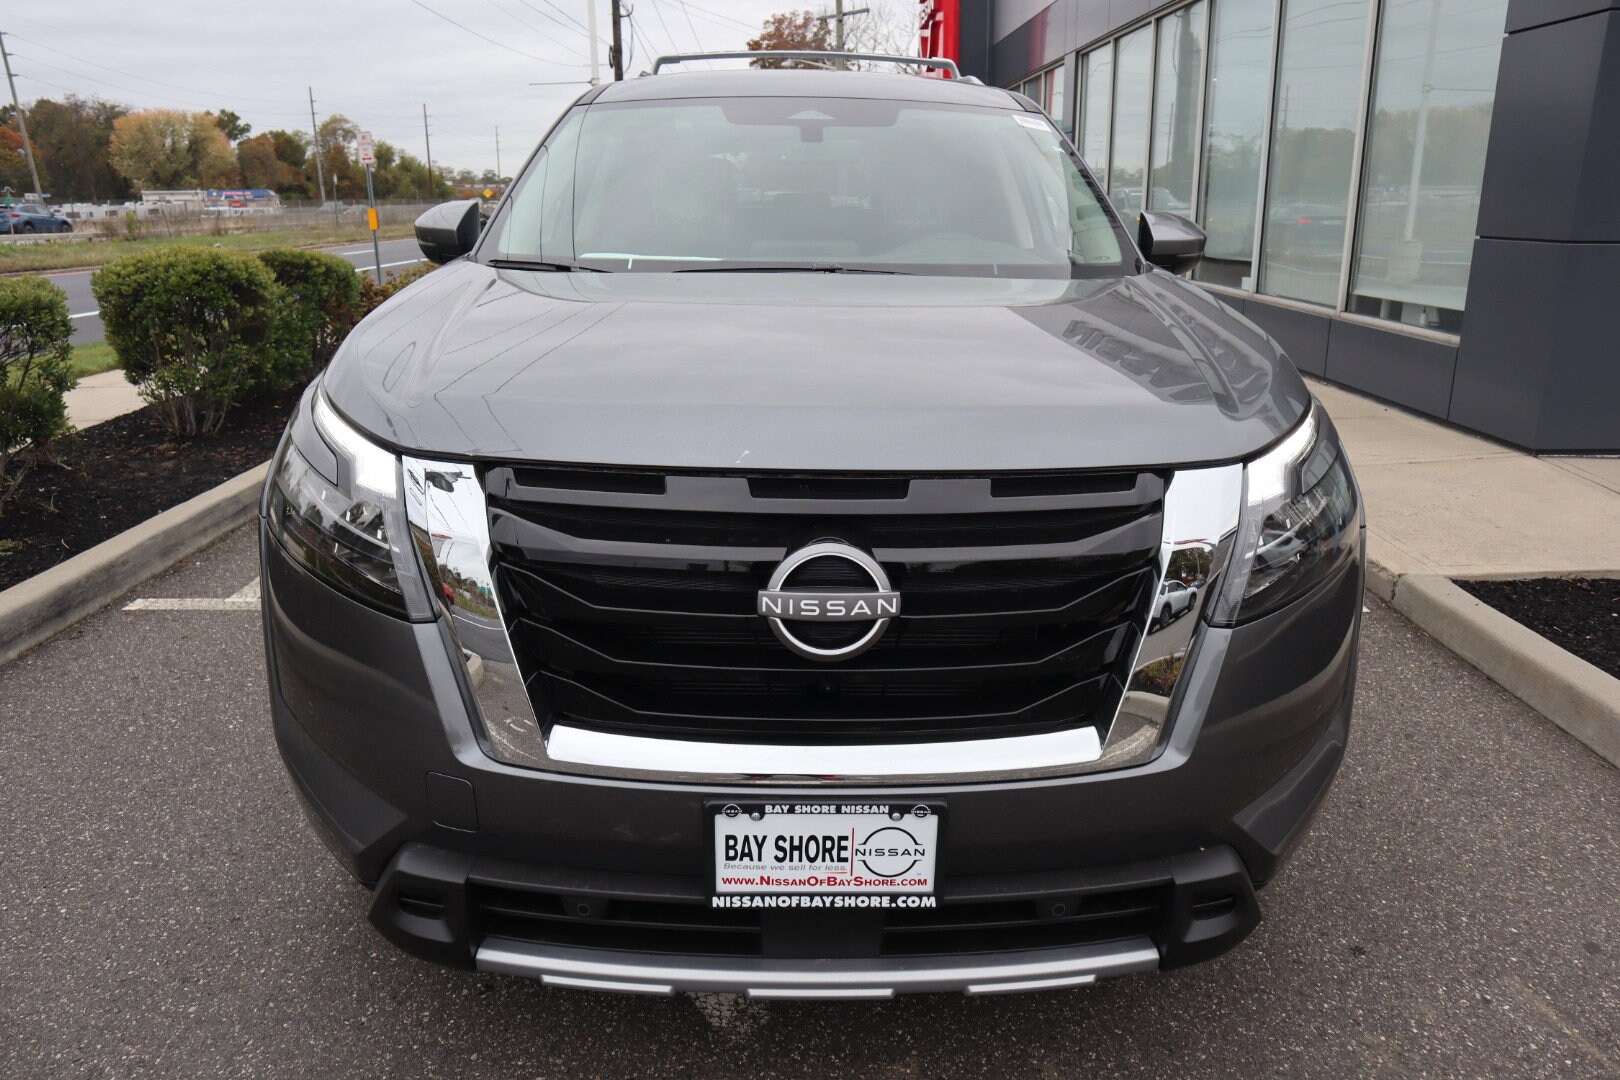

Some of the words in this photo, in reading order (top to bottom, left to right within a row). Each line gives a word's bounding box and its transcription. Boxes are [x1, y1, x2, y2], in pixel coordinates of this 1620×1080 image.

[762, 596, 897, 616] NISSAN
[765, 805, 789, 813] BAY
[795, 805, 836, 813] SHORE
[842, 805, 889, 814] NISSAN
[725, 834, 767, 862] BAY
[774, 834, 849, 863] SHORE
[855, 848, 925, 856] NISSAN
[724, 863, 767, 871] Because
[712, 896, 936, 907] NISSANOFBAYSHORE.COM
